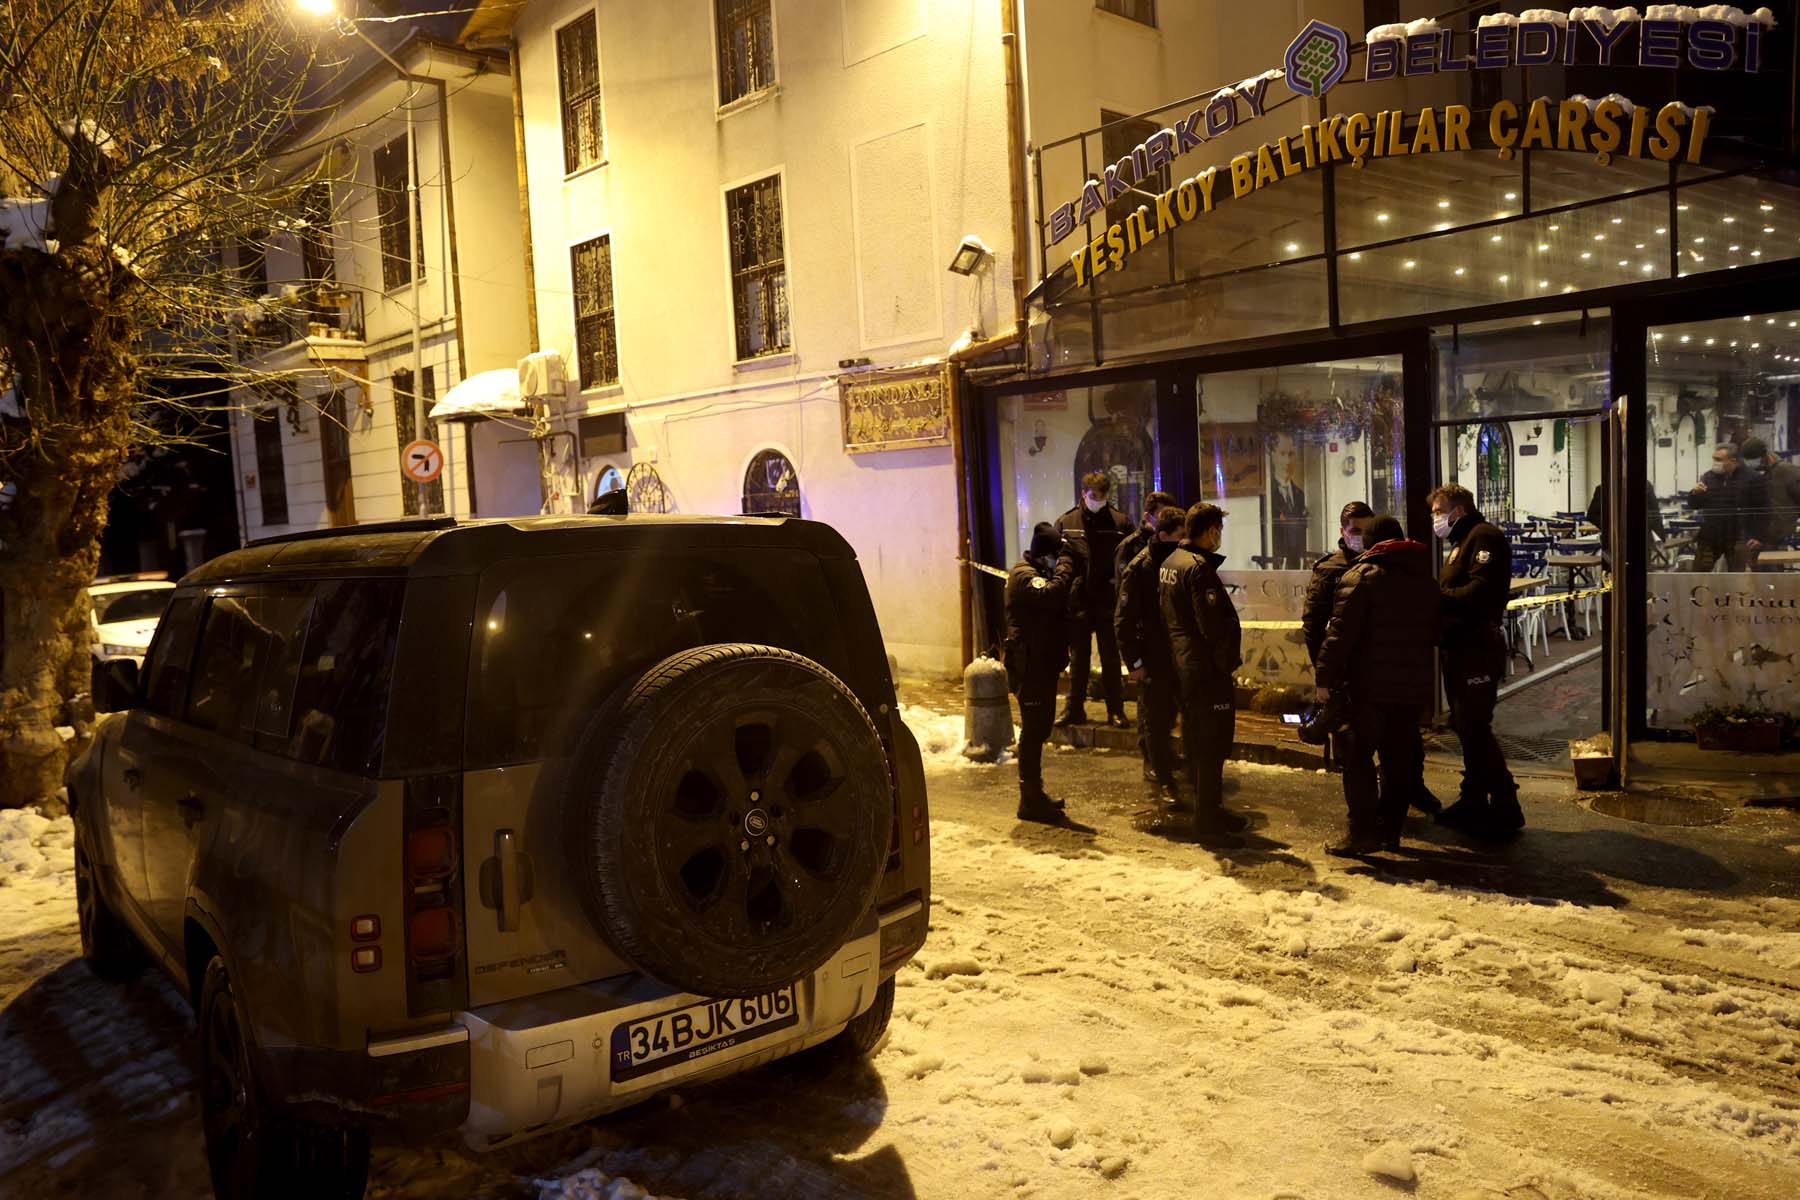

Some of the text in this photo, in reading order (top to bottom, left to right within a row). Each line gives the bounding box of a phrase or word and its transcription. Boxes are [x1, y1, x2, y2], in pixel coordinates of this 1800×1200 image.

[1049, 78, 1268, 245] BAKIRKÖY
[1230, 104, 1473, 200] BALIKÇILAR
[1489, 99, 1710, 167] ÇARŞISI
[617, 1049, 631, 1064] TR
